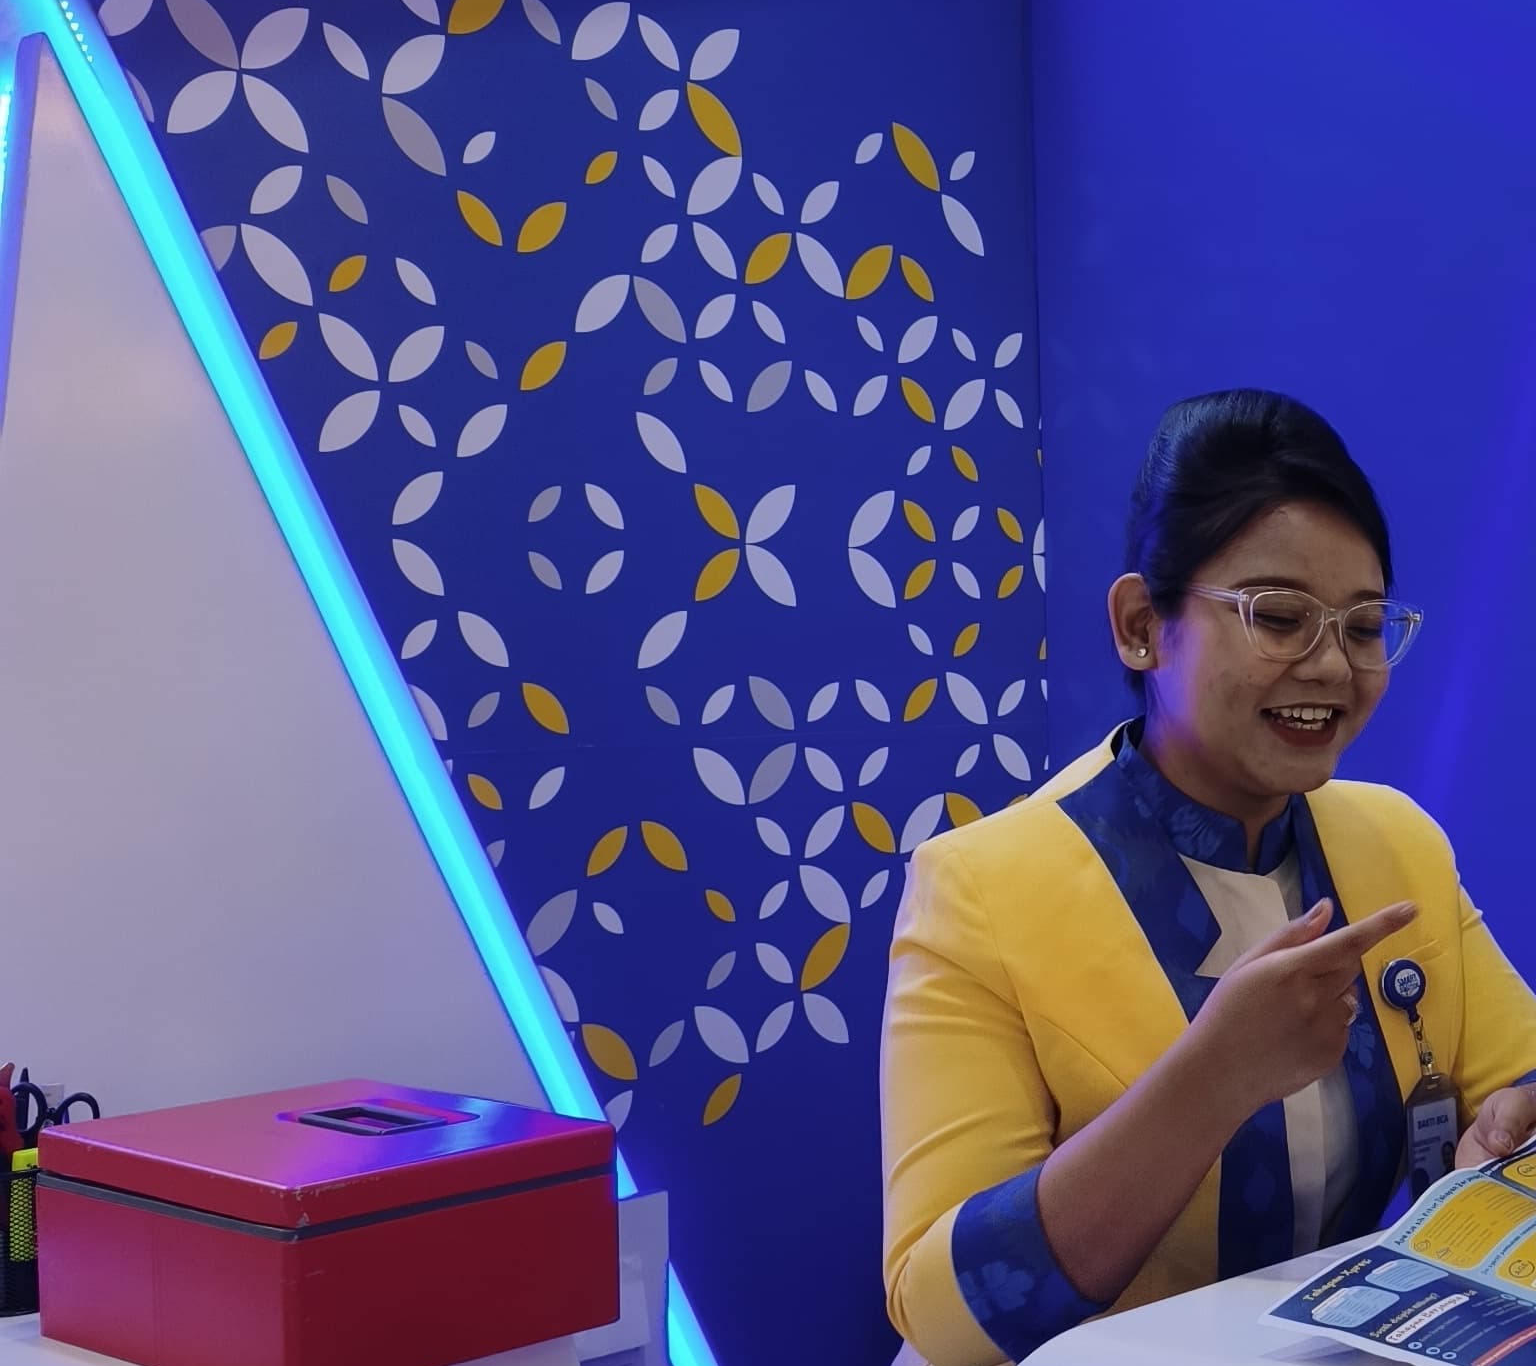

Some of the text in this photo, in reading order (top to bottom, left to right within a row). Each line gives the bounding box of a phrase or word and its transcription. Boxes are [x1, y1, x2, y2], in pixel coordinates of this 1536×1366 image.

[1436, 1114, 1449, 1125] BCA
[1302, 1273, 1346, 1301] Tahapan
[1387, 1312, 1426, 1343] Tahapan
